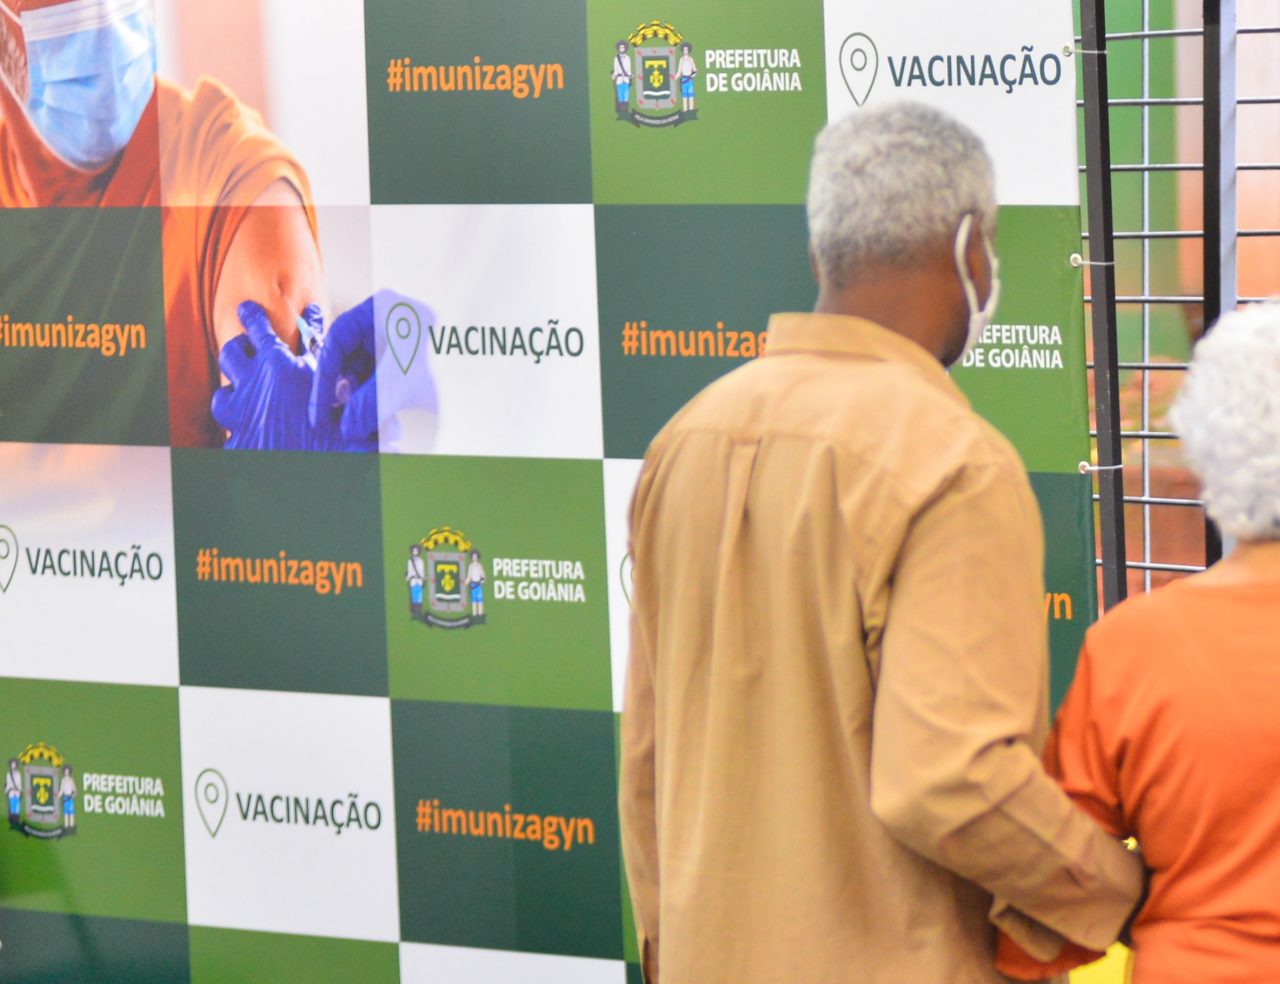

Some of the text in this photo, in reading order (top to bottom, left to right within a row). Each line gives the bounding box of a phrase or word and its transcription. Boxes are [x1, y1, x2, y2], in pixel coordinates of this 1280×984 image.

[705, 49, 801, 68] PREFEITURA
[887, 45, 1062, 94] VACINAÇÃO
[387, 56, 564, 98] #imunizagyn
[706, 68, 802, 92] DE GOIÂNIA
[428, 320, 584, 364] VACINAÇÃO
[978, 325, 1062, 344] EFEITURA
[962, 345, 1063, 368] DE GOIÂNIA
[25, 545, 163, 587] VACINAÇÃO
[197, 549, 363, 594] #imunizagyn
[493, 558, 585, 580] PREFEITURA
[494, 579, 585, 602] DE GOIÂNIA
[83, 773, 164, 796] PREFEITURA
[84, 793, 165, 818] DE GOIÂNIA
[236, 793, 382, 835] VACINAÇÃO
[416, 799, 595, 850] #imunizagyn
